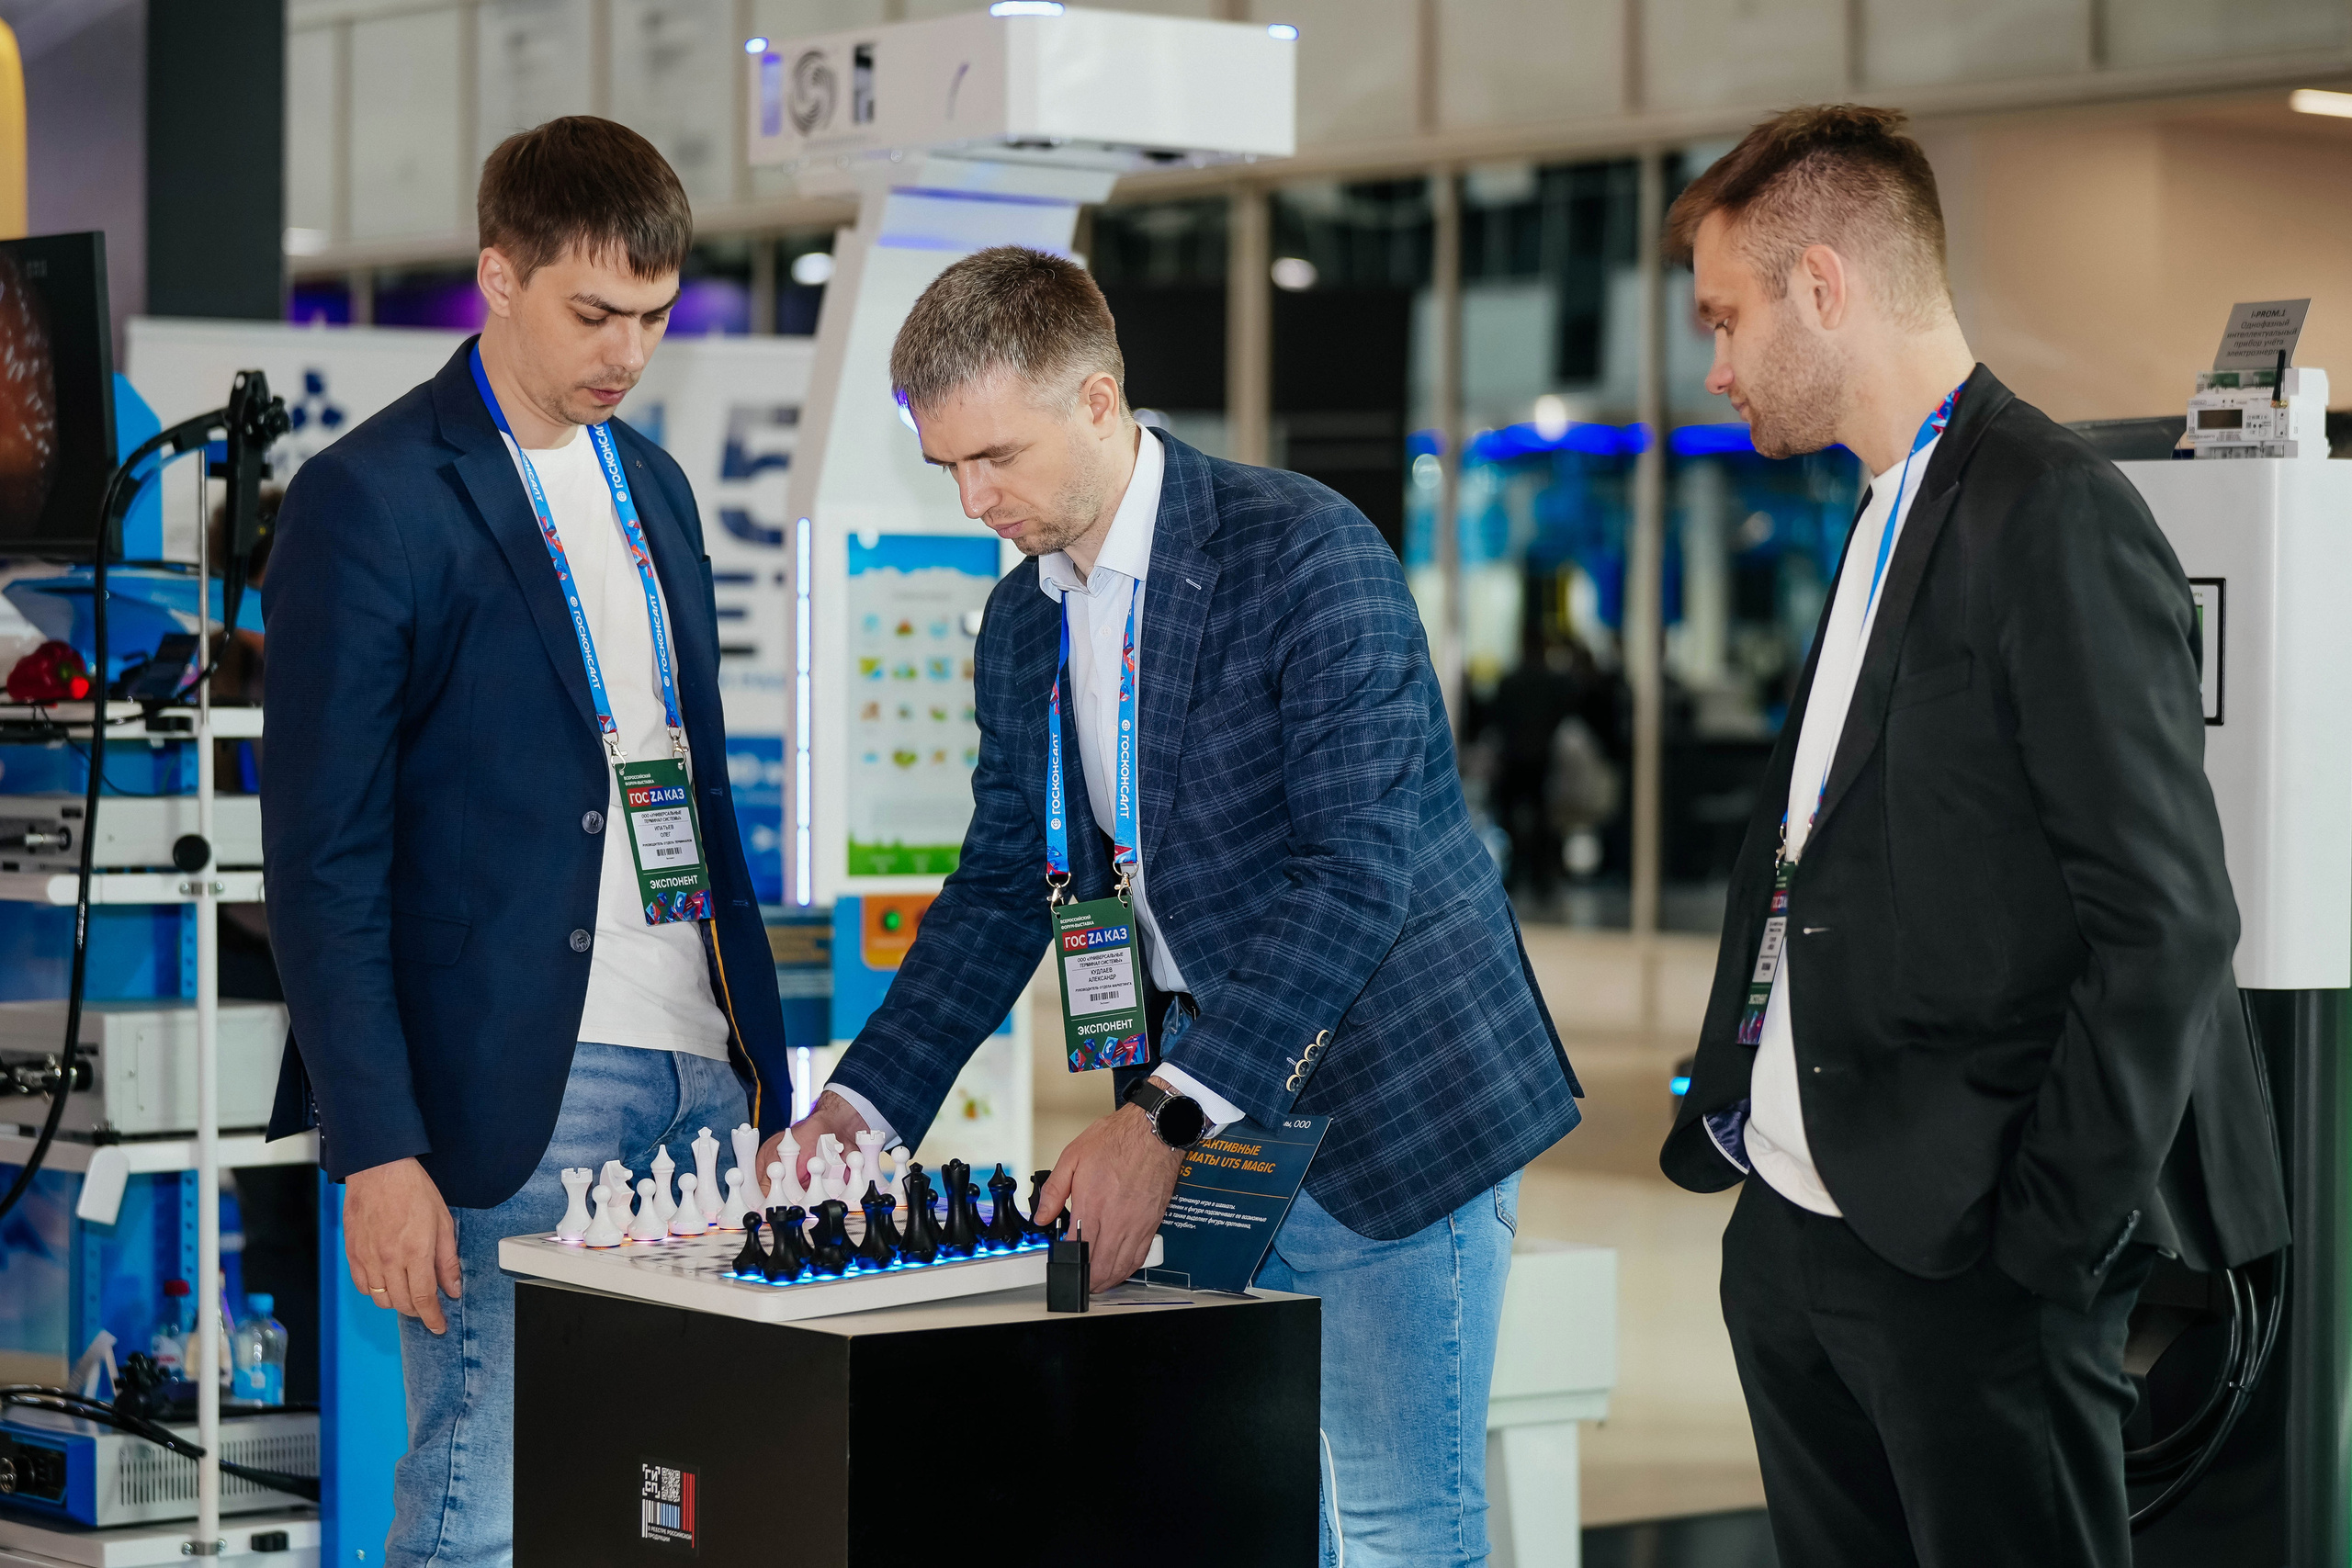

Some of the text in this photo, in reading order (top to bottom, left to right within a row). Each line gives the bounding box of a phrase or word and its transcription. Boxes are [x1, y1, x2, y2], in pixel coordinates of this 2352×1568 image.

[2240, 320, 2290, 329] Однофазный
[593, 422, 624, 489] ГОСКОНСАЛ
[649, 593, 669, 672] ГОСКОНСАЛТ
[573, 610, 601, 690] ГОСКОНСАЛТ
[1051, 733, 1060, 815] ГОСКОНСАЛТ
[1119, 735, 1130, 819] ГОСКОНСАЛТ
[650, 874, 698, 889] ЭКСПОНЕНТ
[1064, 935, 1086, 948] ГОС
[1088, 974, 1117, 983] АЛЕКСАНДР
[1077, 1019, 1133, 1036] ЭКСПОНЕНТ
[1185, 1150, 1275, 1174] МАТЫ UTS MAGIC
